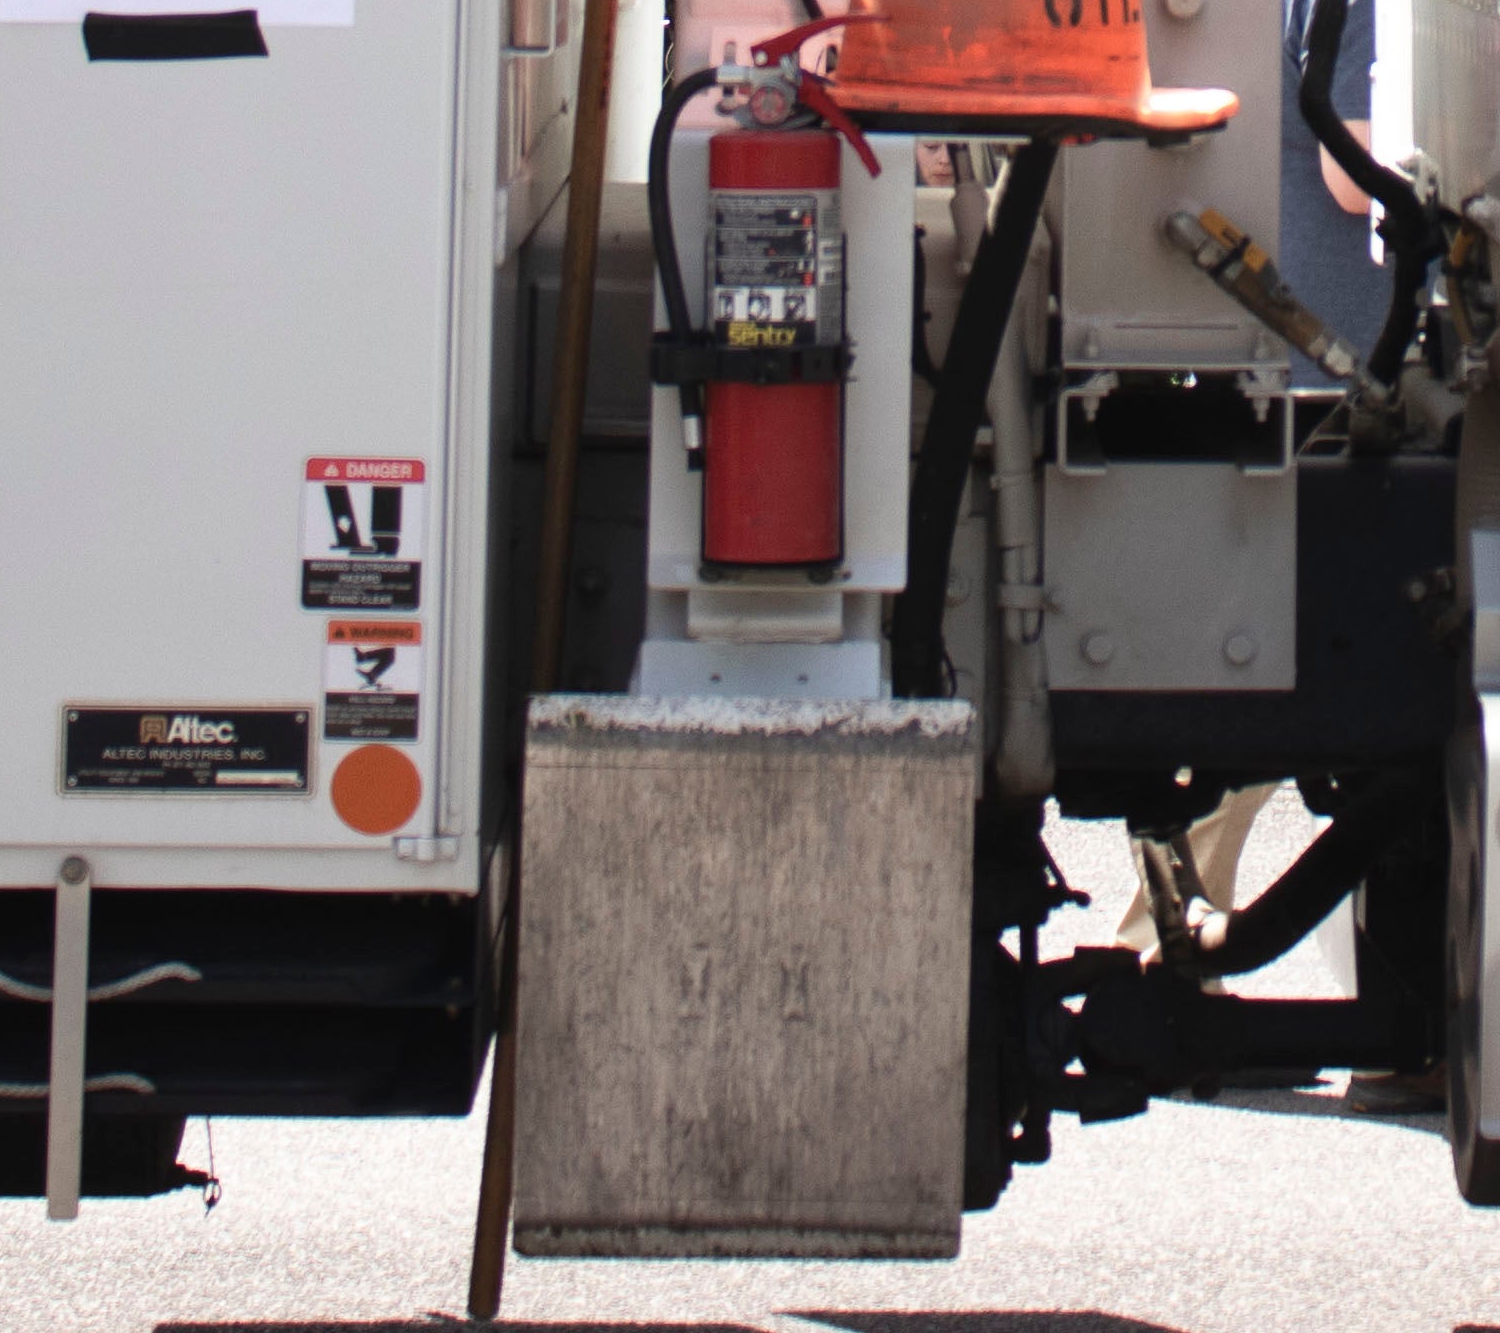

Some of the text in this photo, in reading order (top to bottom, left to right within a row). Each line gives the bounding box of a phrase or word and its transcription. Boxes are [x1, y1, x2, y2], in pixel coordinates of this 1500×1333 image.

[346, 462, 413, 478] DANGER
[167, 715, 235, 743] Altec
[102, 748, 146, 760] ALTEC
